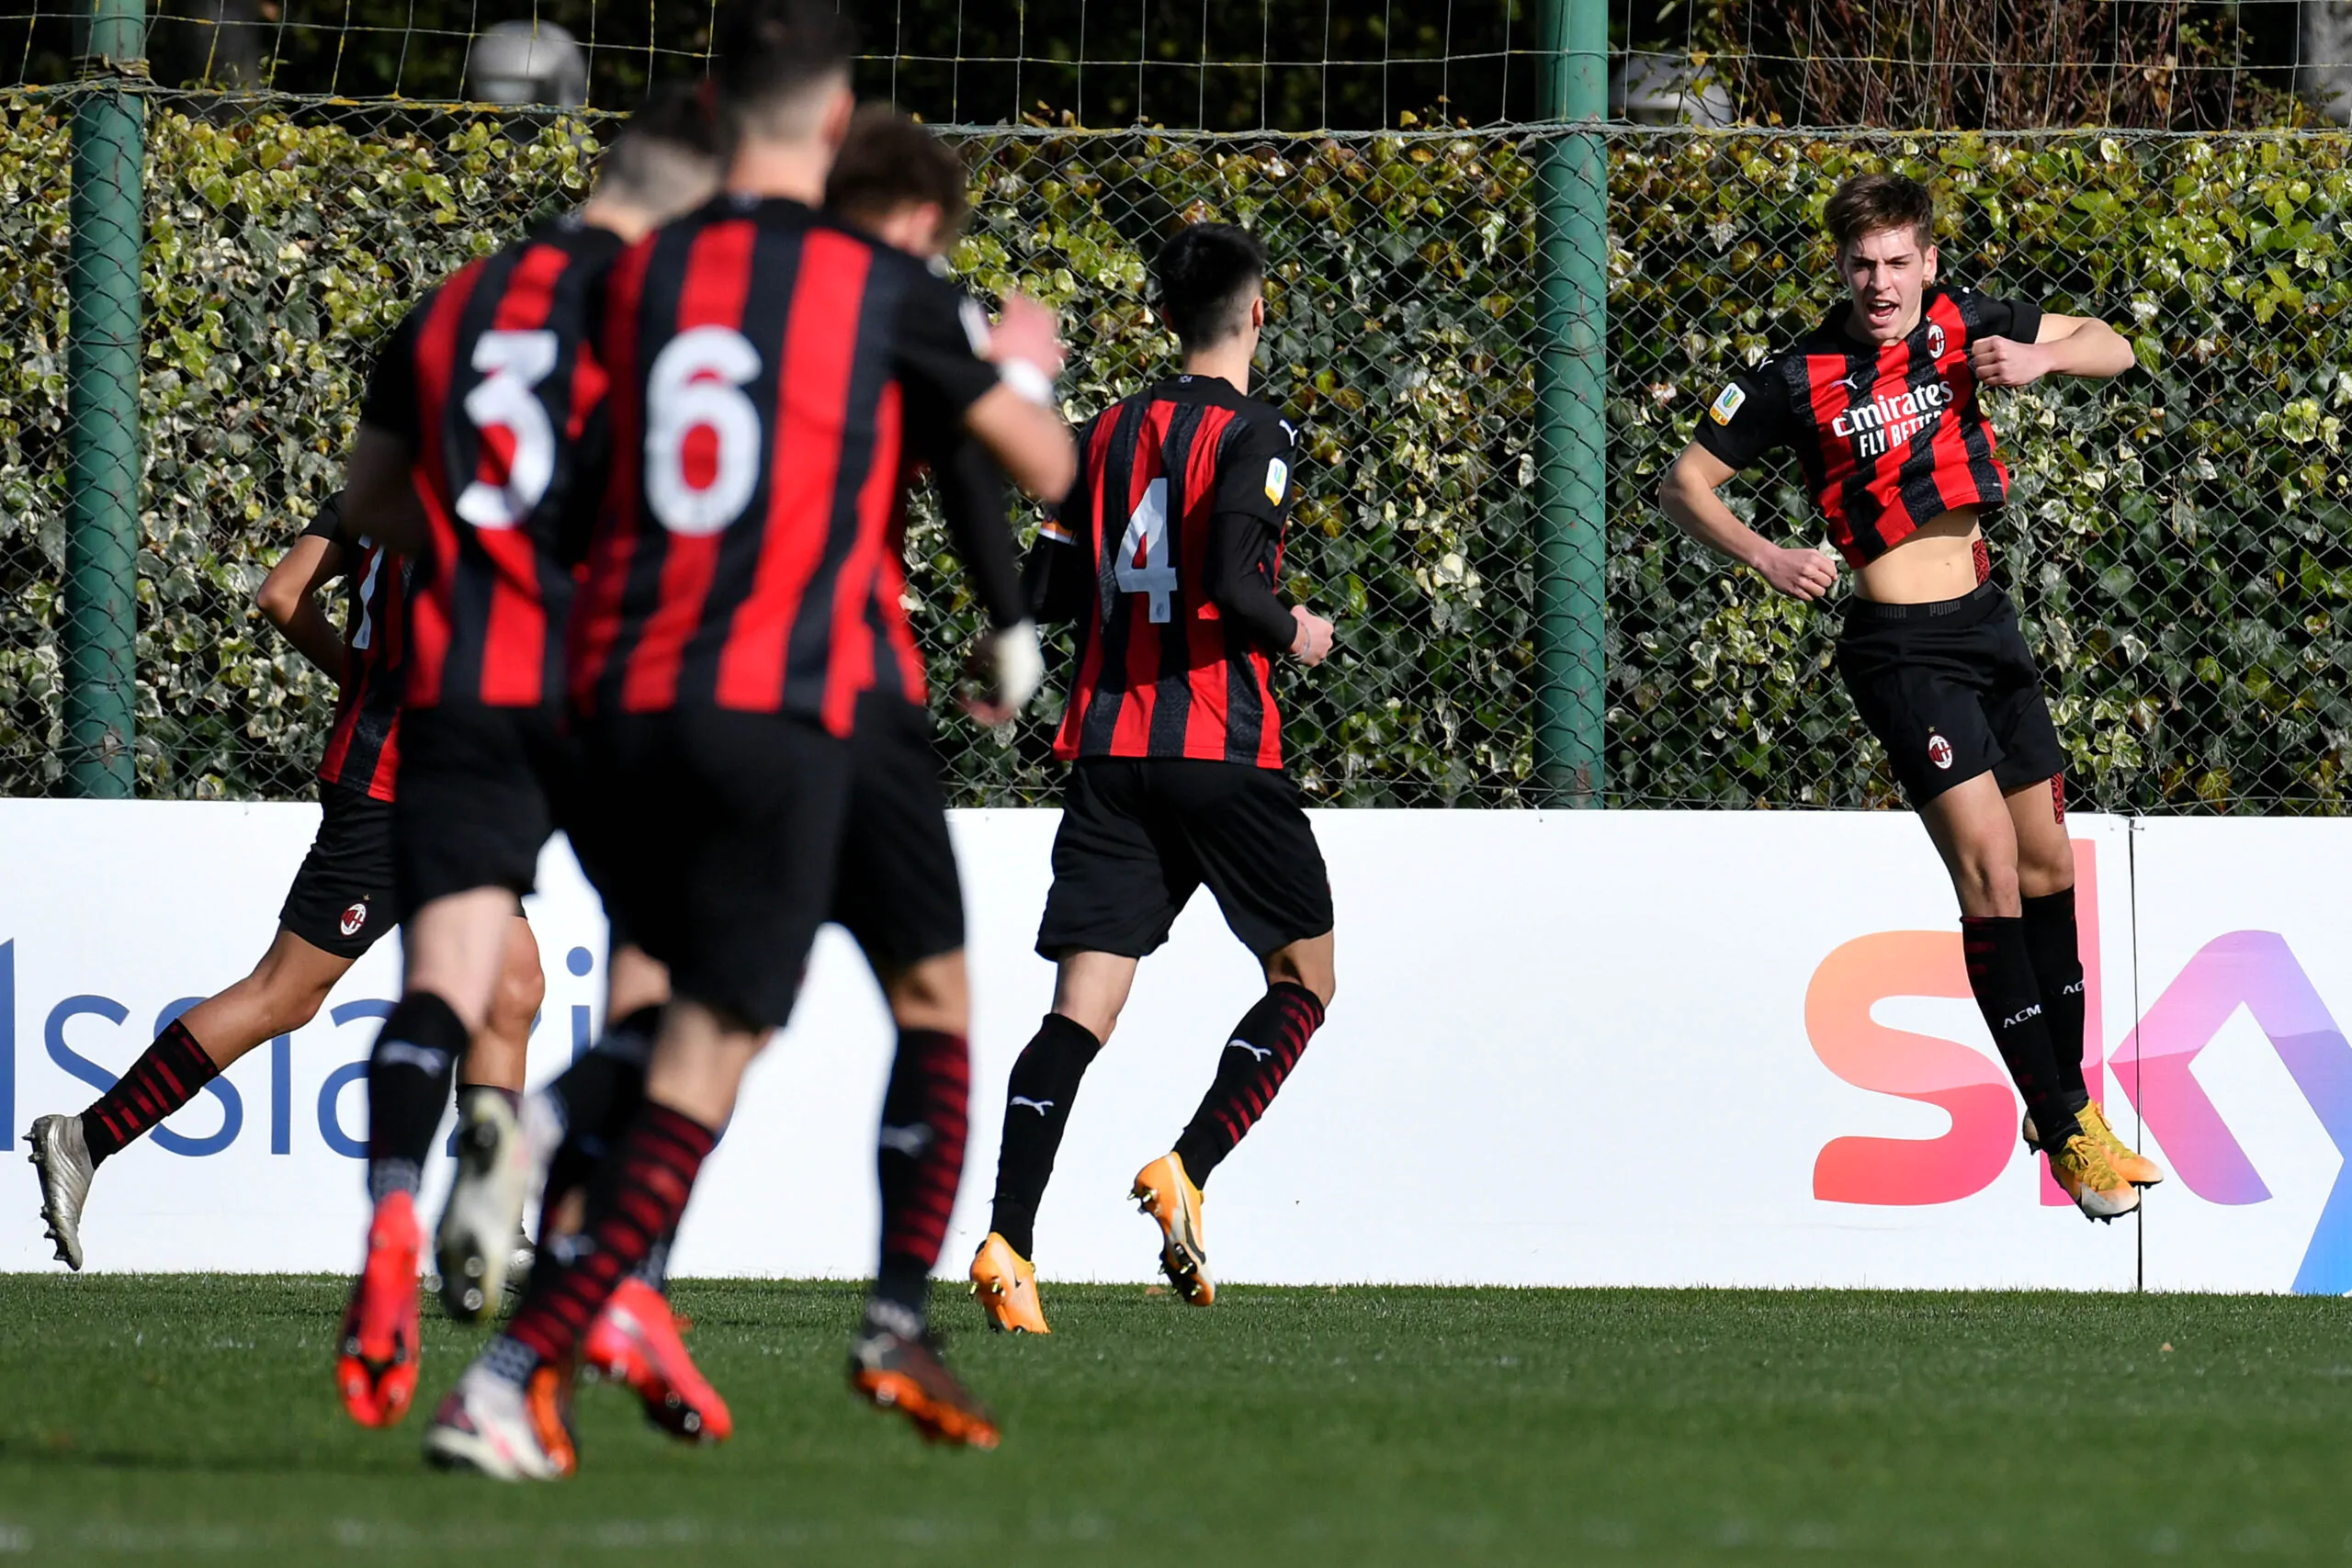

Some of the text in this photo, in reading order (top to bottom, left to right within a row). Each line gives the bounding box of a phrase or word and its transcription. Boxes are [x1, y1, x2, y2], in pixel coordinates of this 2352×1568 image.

[456, 330, 559, 530] 3
[645, 324, 763, 536] 6
[1831, 380, 1953, 437] Emirates
[1859, 428, 1885, 457] FLY
[1114, 477, 1177, 623] 4
[2003, 1003, 2042, 1029] ACM
